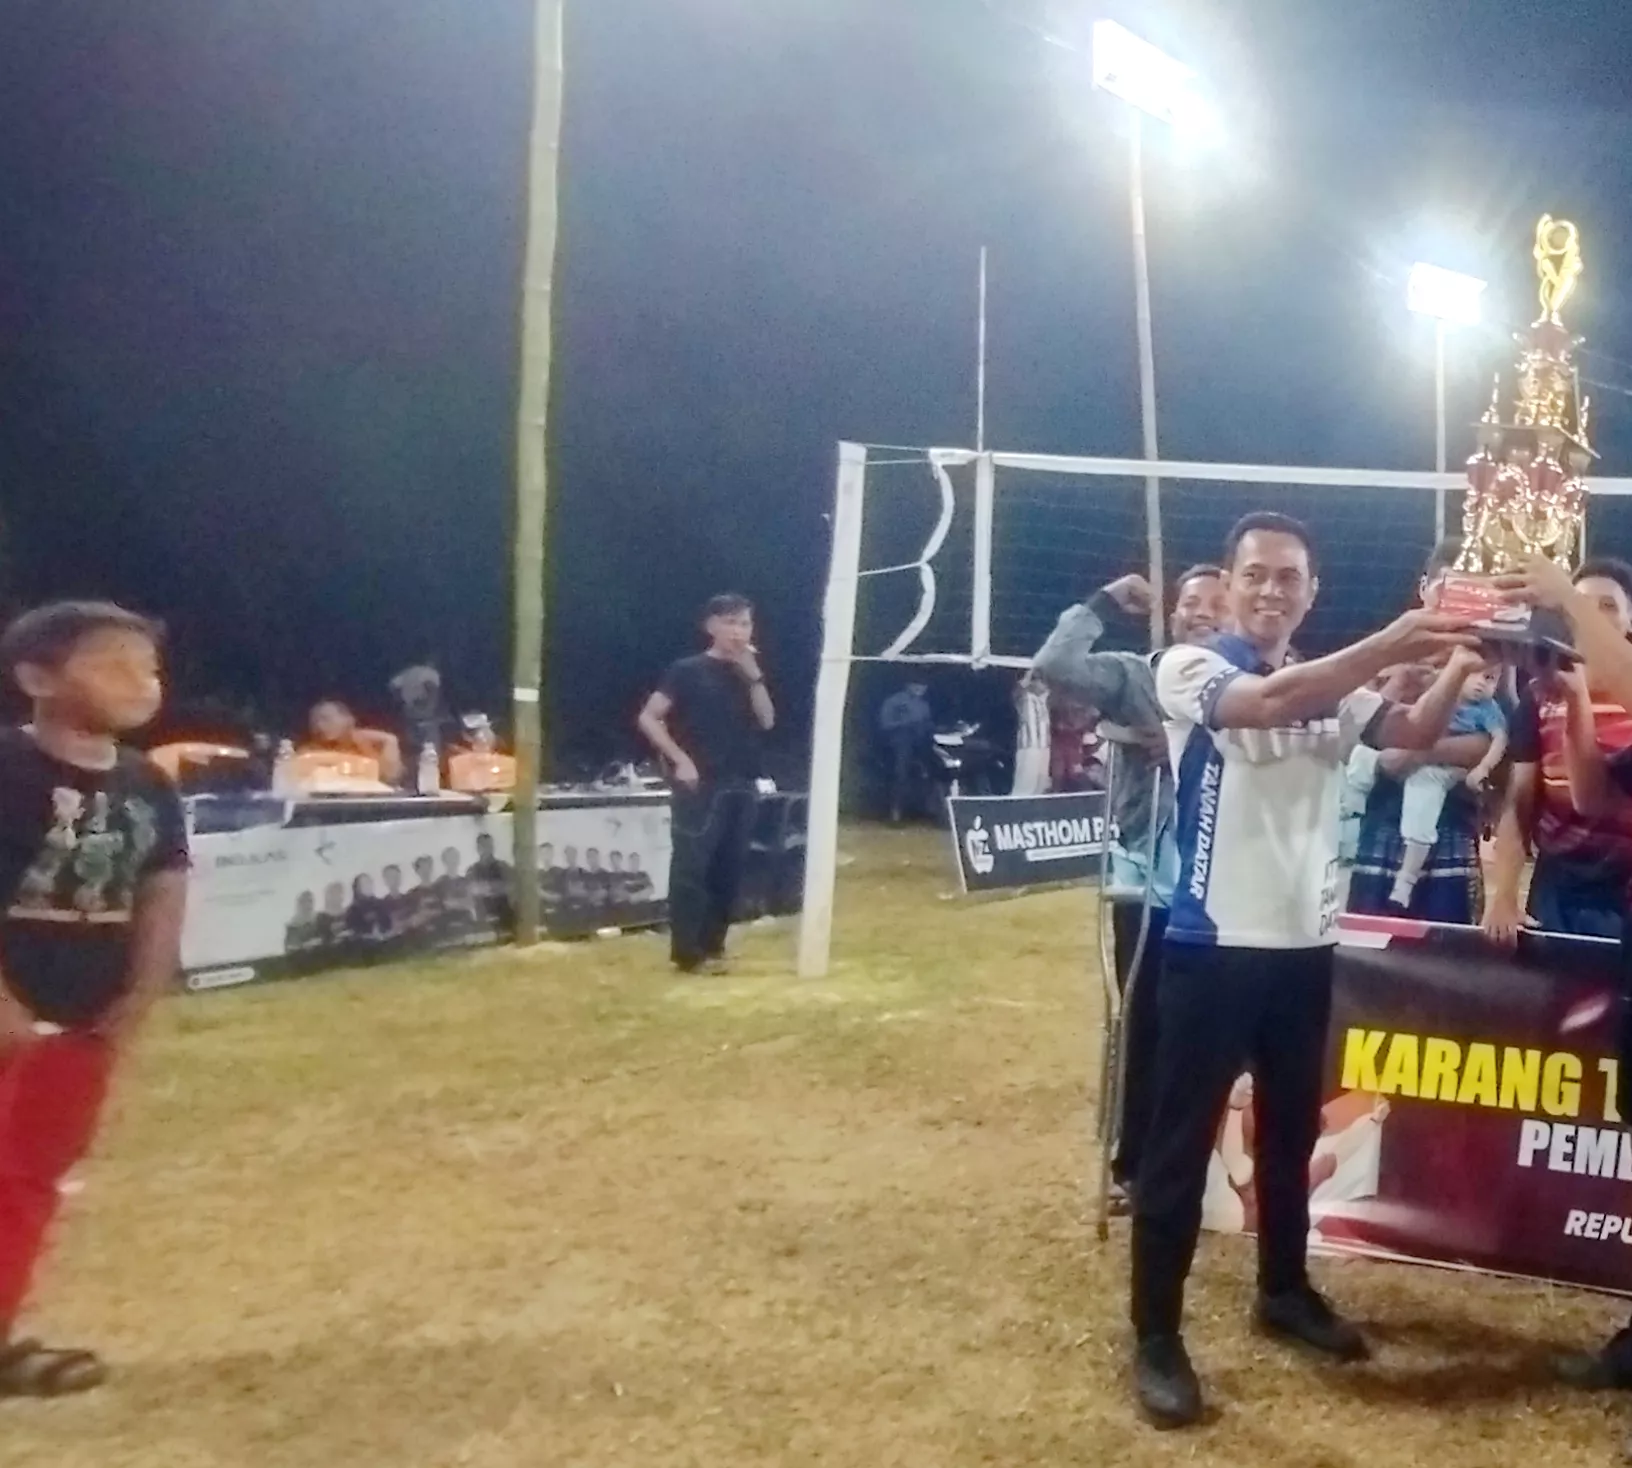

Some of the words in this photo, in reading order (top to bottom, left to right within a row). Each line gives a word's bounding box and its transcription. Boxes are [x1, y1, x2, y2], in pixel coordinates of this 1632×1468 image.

[993, 816, 1092, 852] MASTHOM
[1198, 762, 1220, 836] TANAH
[1189, 831, 1213, 900] DATAR
[1341, 1028, 1583, 1117] KARANG
